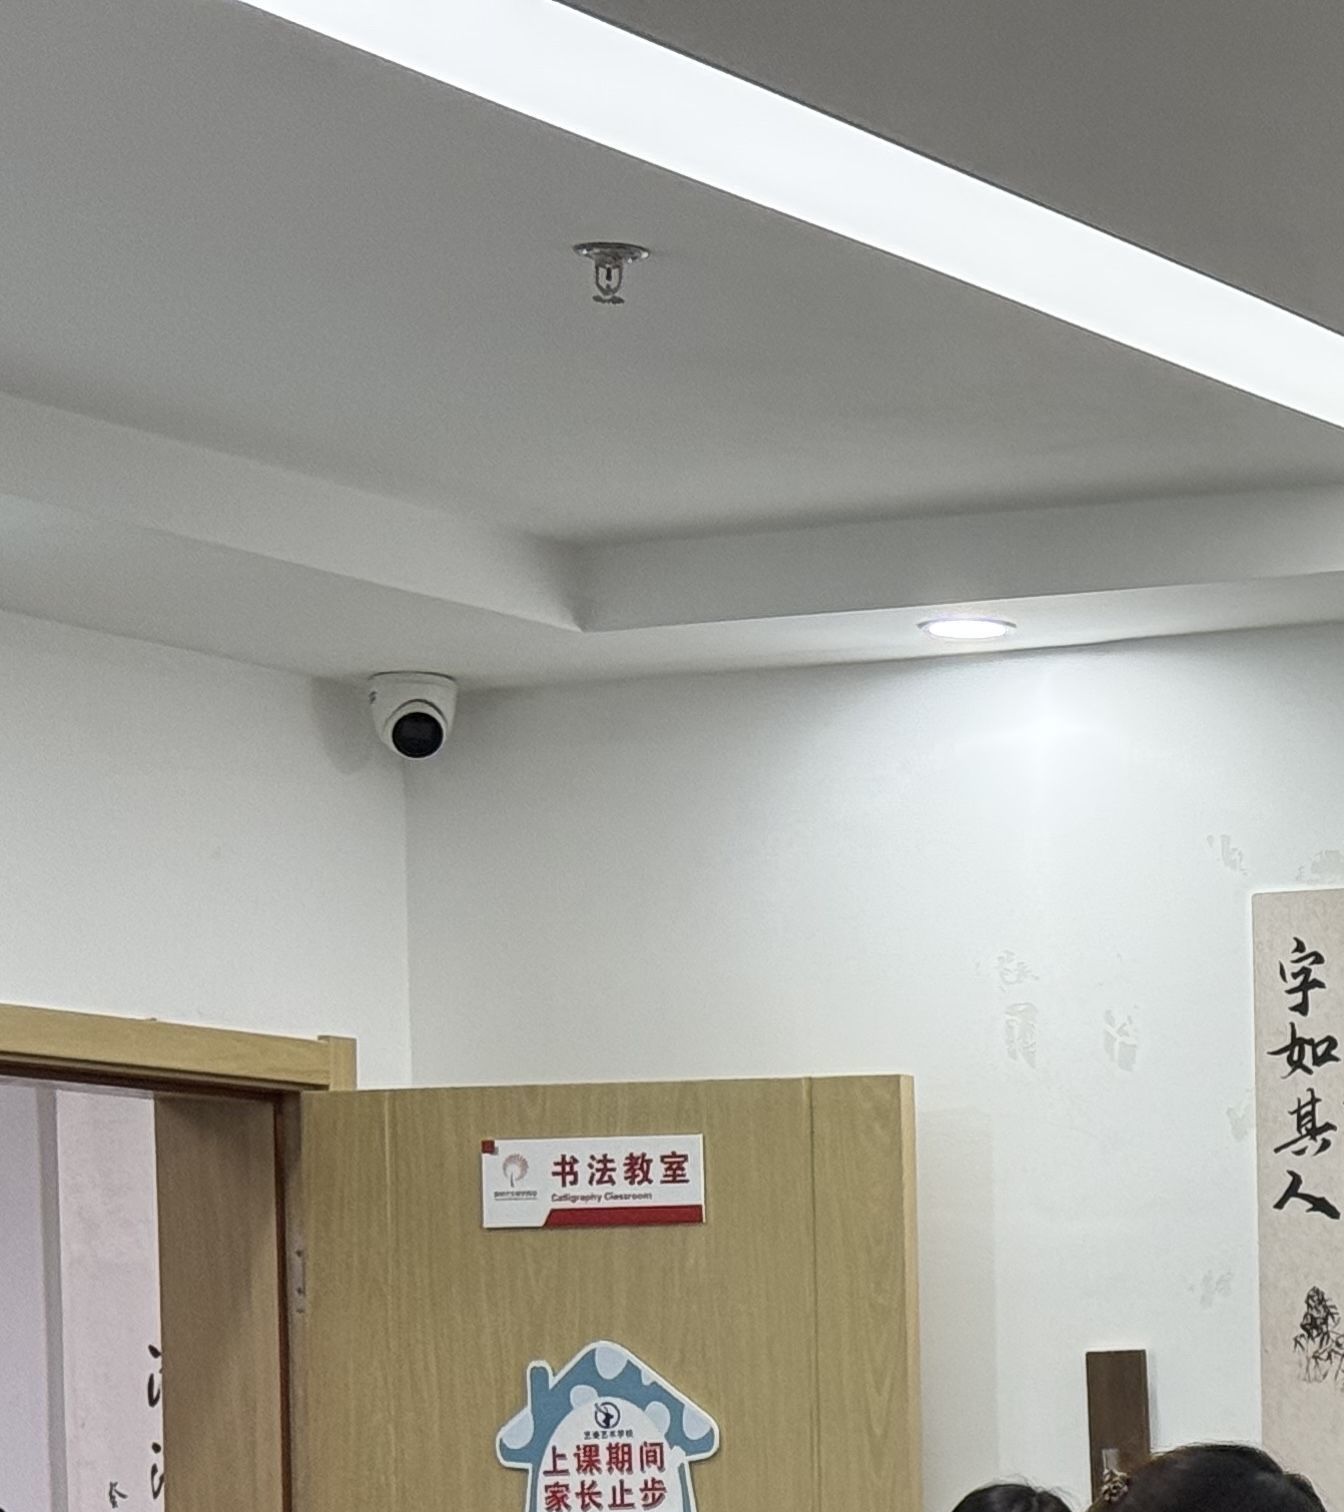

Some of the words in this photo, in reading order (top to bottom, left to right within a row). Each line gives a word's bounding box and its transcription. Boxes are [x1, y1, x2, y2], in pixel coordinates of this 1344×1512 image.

[1268, 937, 1341, 1220] 字如其人
[551, 1150, 690, 1188] 书法教室
[543, 1441, 666, 1477] 上课期间
